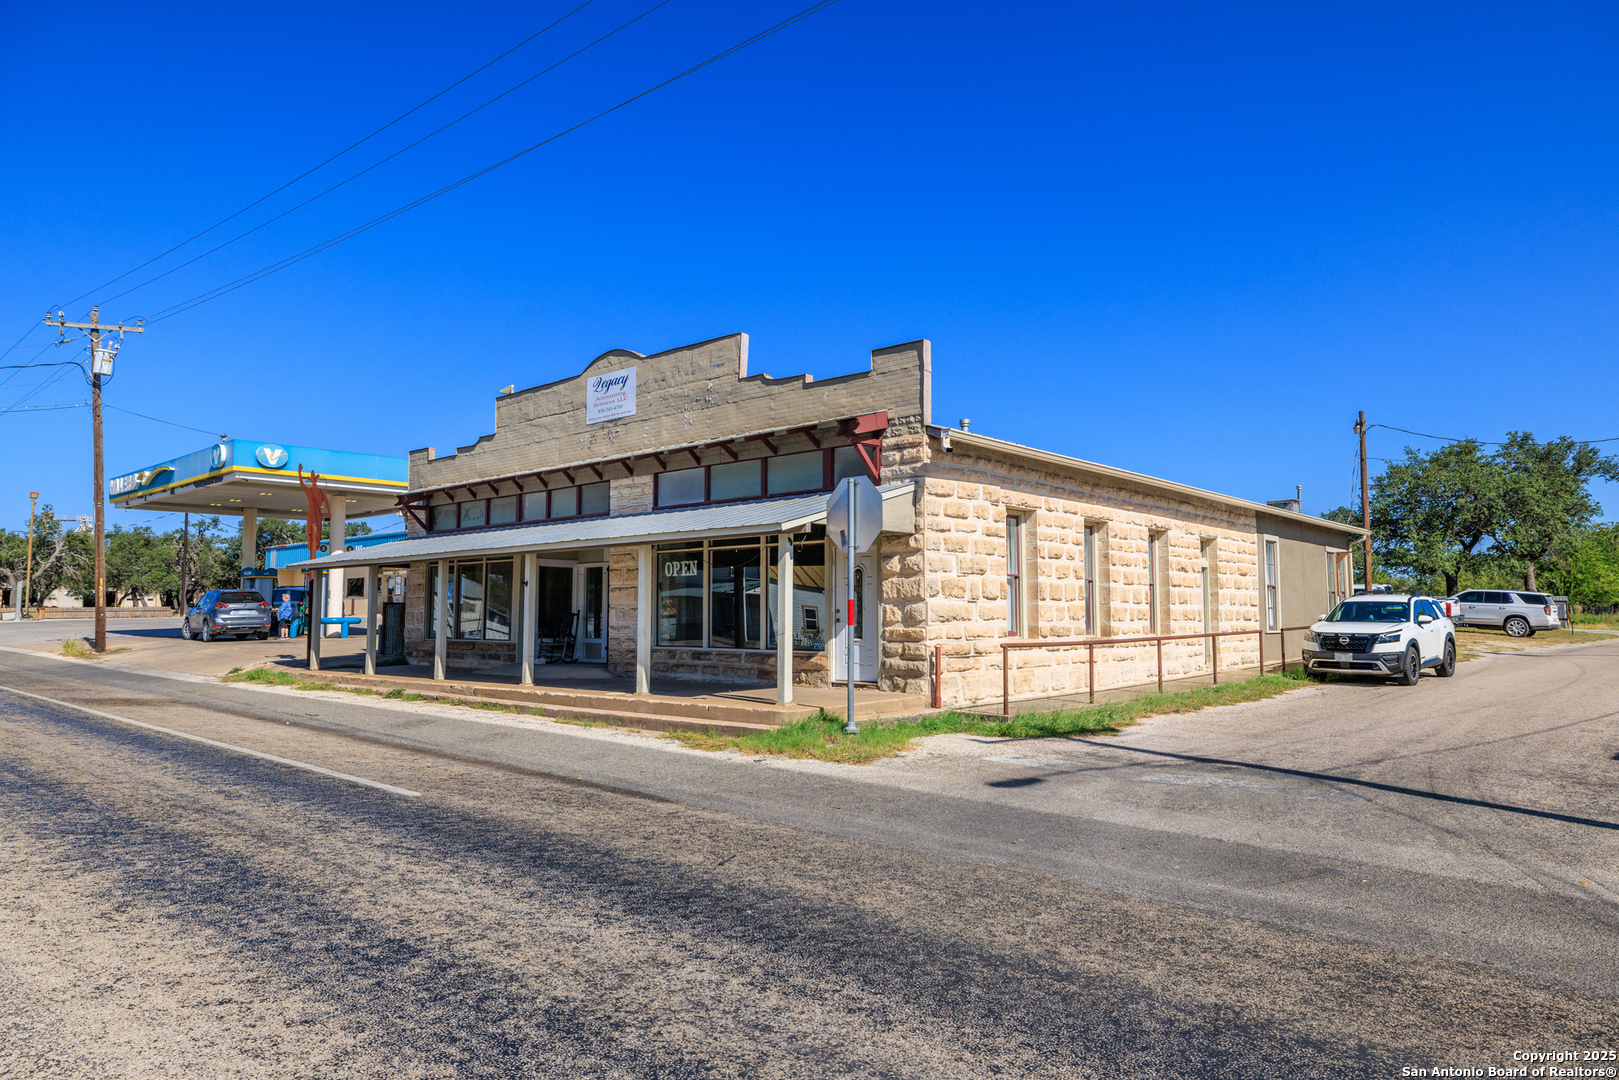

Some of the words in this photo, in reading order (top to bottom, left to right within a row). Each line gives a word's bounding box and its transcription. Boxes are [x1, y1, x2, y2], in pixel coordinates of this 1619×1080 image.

[592, 374, 630, 395] Legacy
[593, 400, 615, 409] Services
[595, 391, 627, 402] Accounting
[263, 447, 283, 465] V
[664, 560, 698, 577] OPEN
